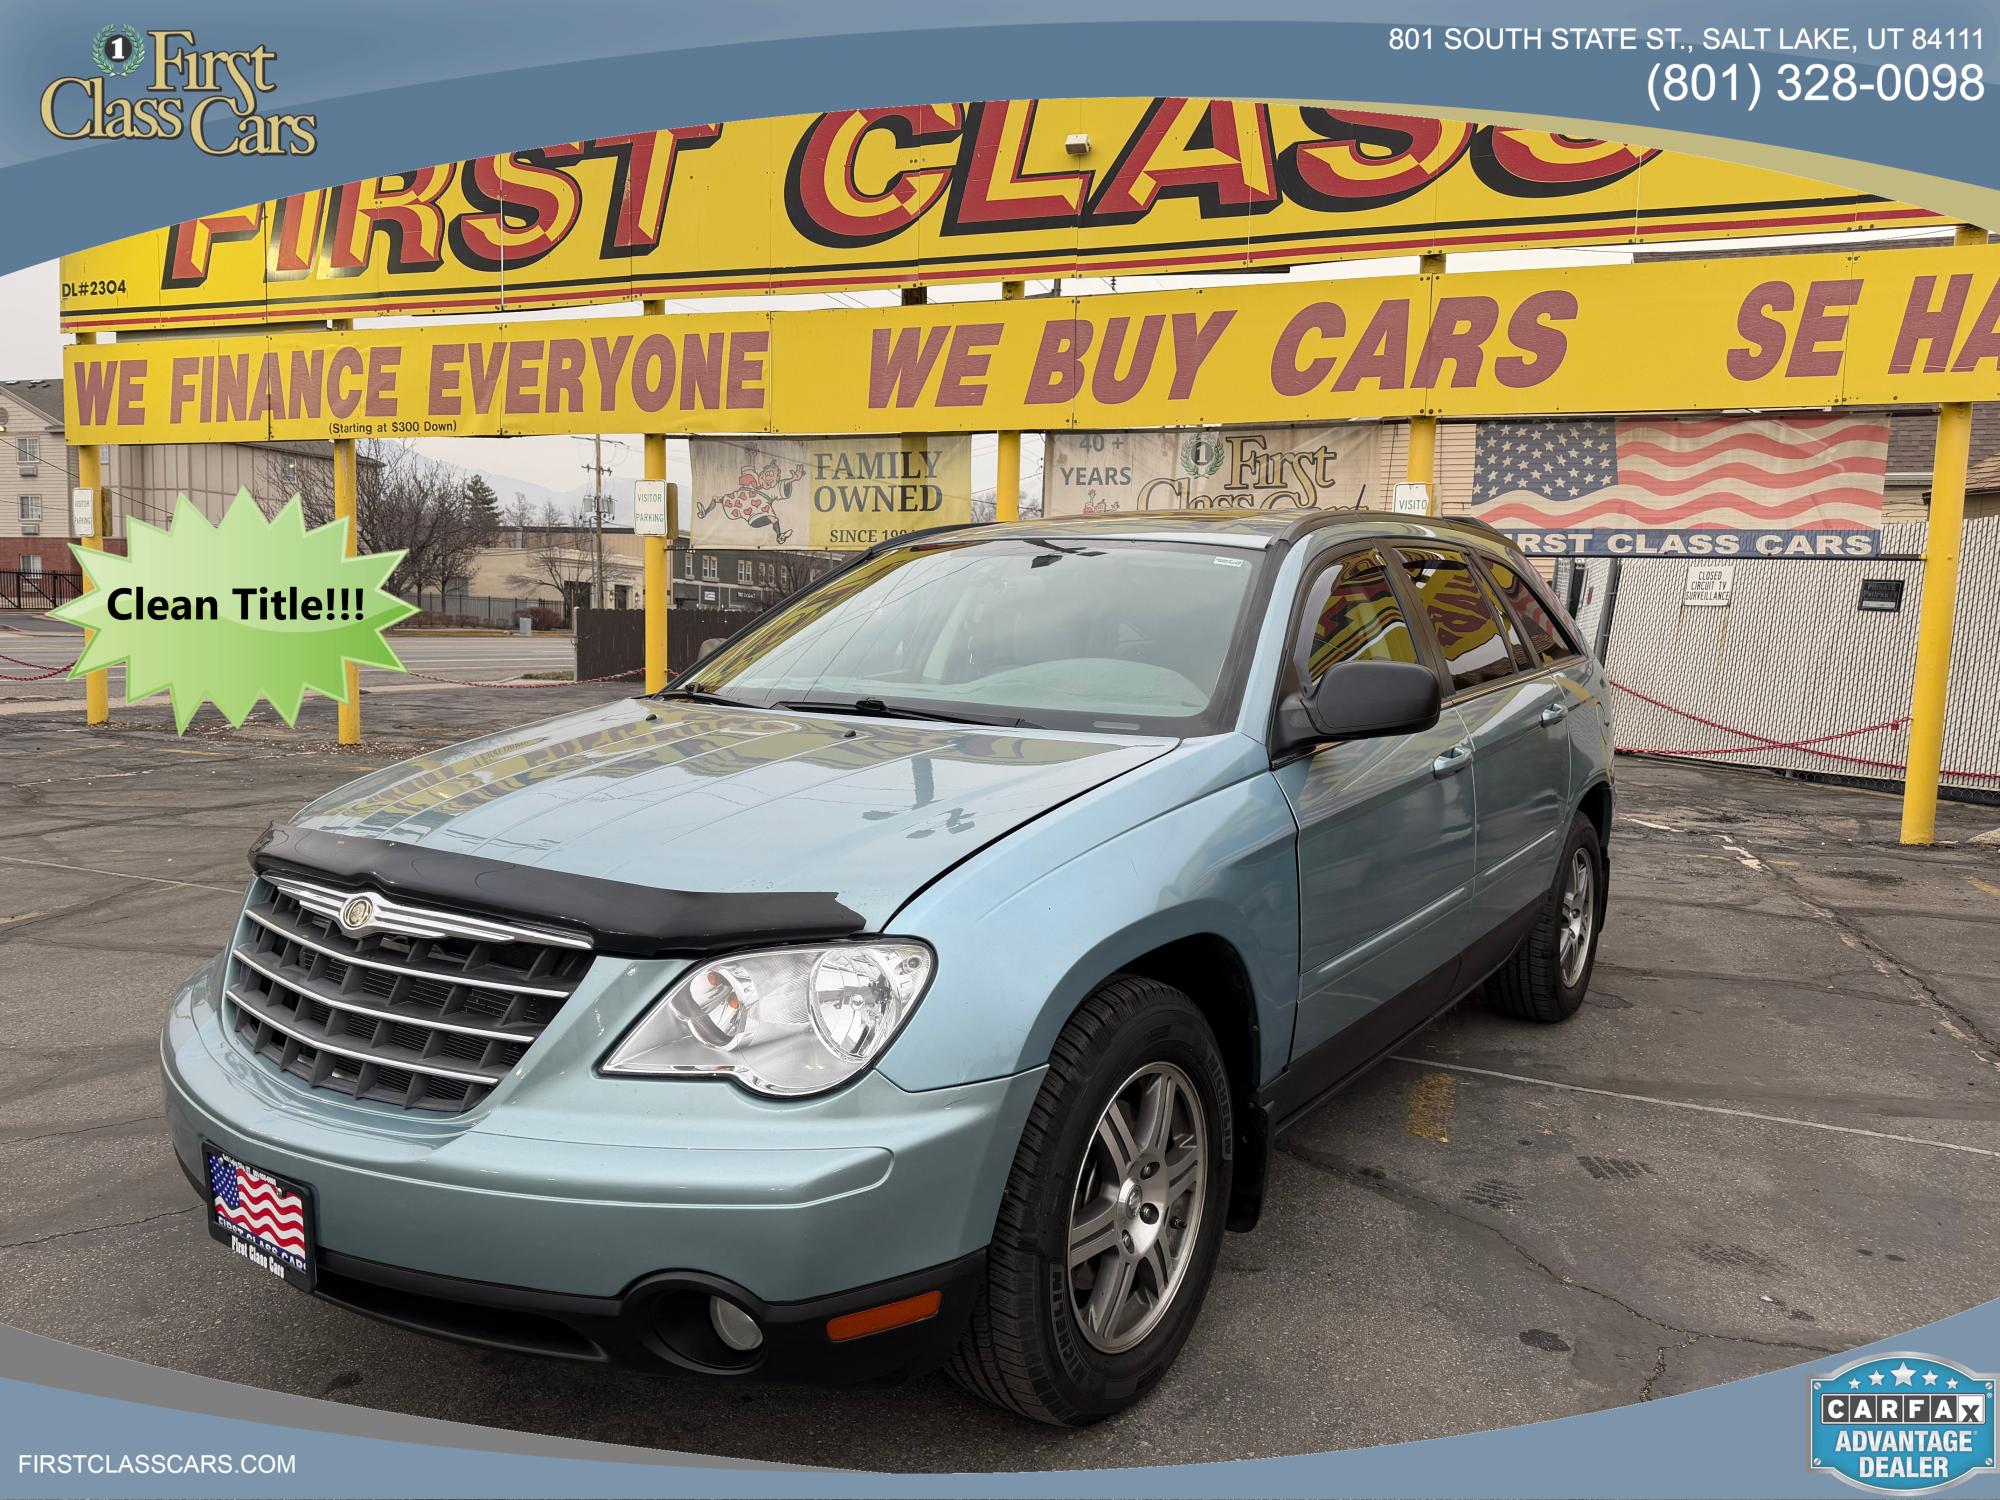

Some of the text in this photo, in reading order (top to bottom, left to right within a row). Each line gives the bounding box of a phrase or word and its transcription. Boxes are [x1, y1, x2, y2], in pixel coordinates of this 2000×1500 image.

[74, 359, 148, 425] WE
[169, 346, 402, 424] FINANCE
[428, 330, 769, 416] EVERYONE
[868, 323, 1004, 408] WE
[1024, 310, 1238, 405] BUY
[1270, 290, 1578, 396] CARS
[1726, 279, 1864, 381] SE
[329, 419, 457, 434] (Starting at $300 Down)
[814, 451, 943, 480] FAMILY
[1225, 435, 1337, 509] First
[1060, 466, 1131, 486] YEARS
[637, 493, 662, 502] VISITOR
[814, 485, 943, 512] OWNED
[636, 513, 664, 522] PARKING
[830, 529, 877, 543] SINCE
[1607, 533, 1740, 554] CLASS
[1755, 535, 1872, 554] CARS
[1699, 571, 1722, 580] CLOSED
[1691, 581, 1728, 590] CIRCUIT TV
[1686, 591, 1730, 600] SURVEILLANCE
[231, 1235, 285, 1279] First Class Cars
